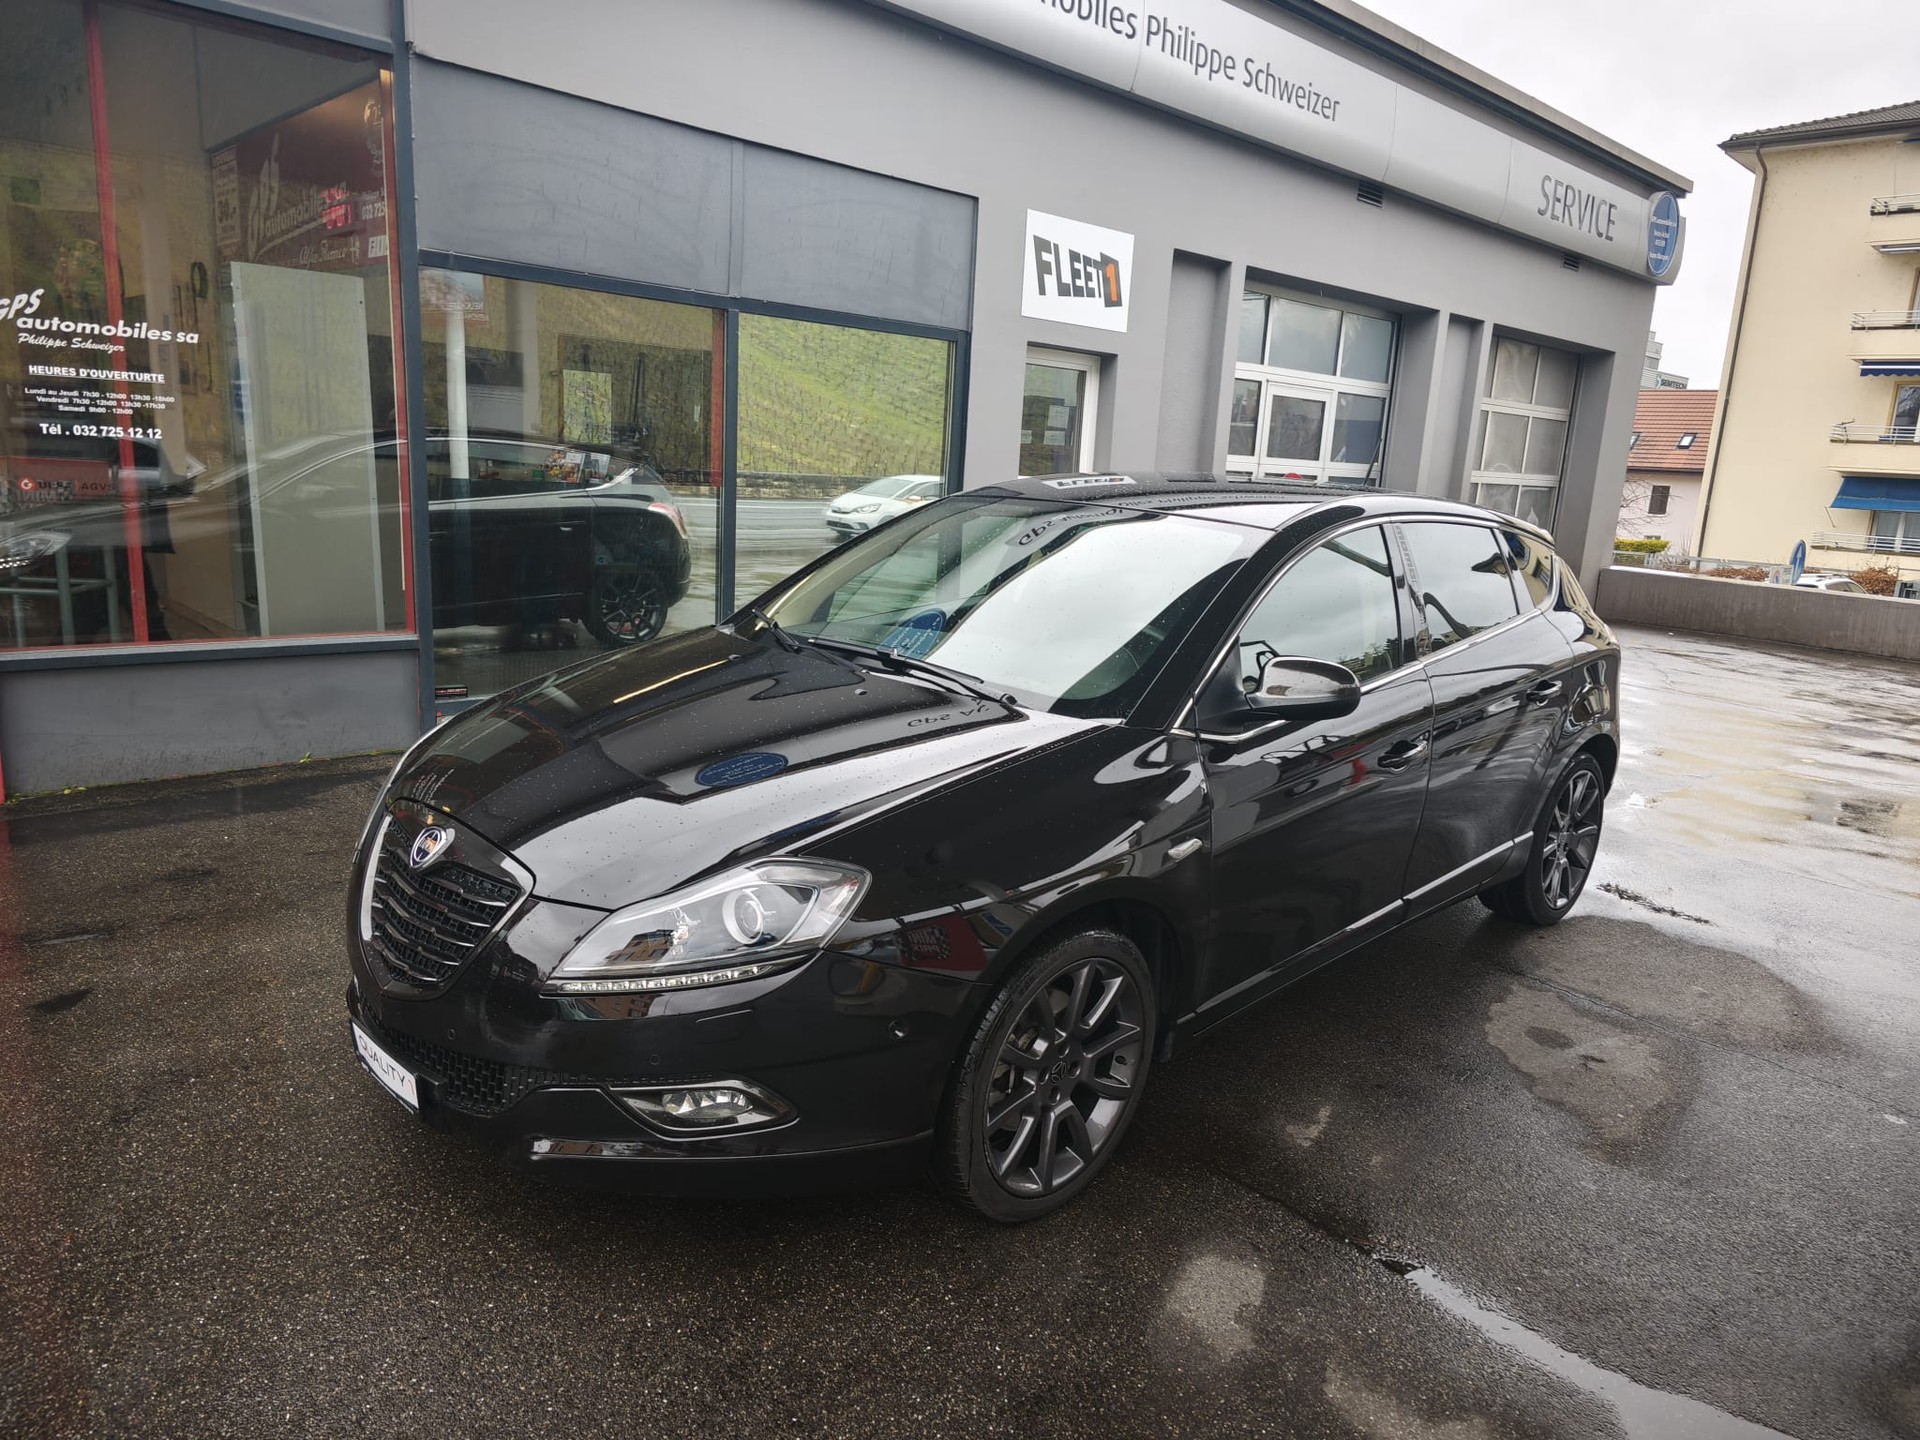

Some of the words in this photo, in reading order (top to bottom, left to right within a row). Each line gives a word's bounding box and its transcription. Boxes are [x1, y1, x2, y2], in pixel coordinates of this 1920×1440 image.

[1145, 14, 1236, 81] Philippe
[1242, 57, 1340, 122] Schweizer
[1537, 174, 1618, 242] SERVICE
[16, 316, 172, 341] automobiles
[176, 331, 199, 344] sa
[17, 333, 68, 349] Philippe
[70, 337, 125, 355] Schweizer
[28, 364, 77, 377] HEURES
[79, 367, 165, 384] D'OUVERTURTE
[24, 387, 46, 395] Lundi
[58, 389, 79, 397] Jeudi
[35, 395, 69, 404] Vendredi
[58, 404, 86, 412] Samedi
[39, 423, 61, 435] Tél
[73, 424, 98, 436] 032
[100, 425, 124, 437] 725
[127, 427, 143, 438] 12
[147, 428, 162, 439] 12
